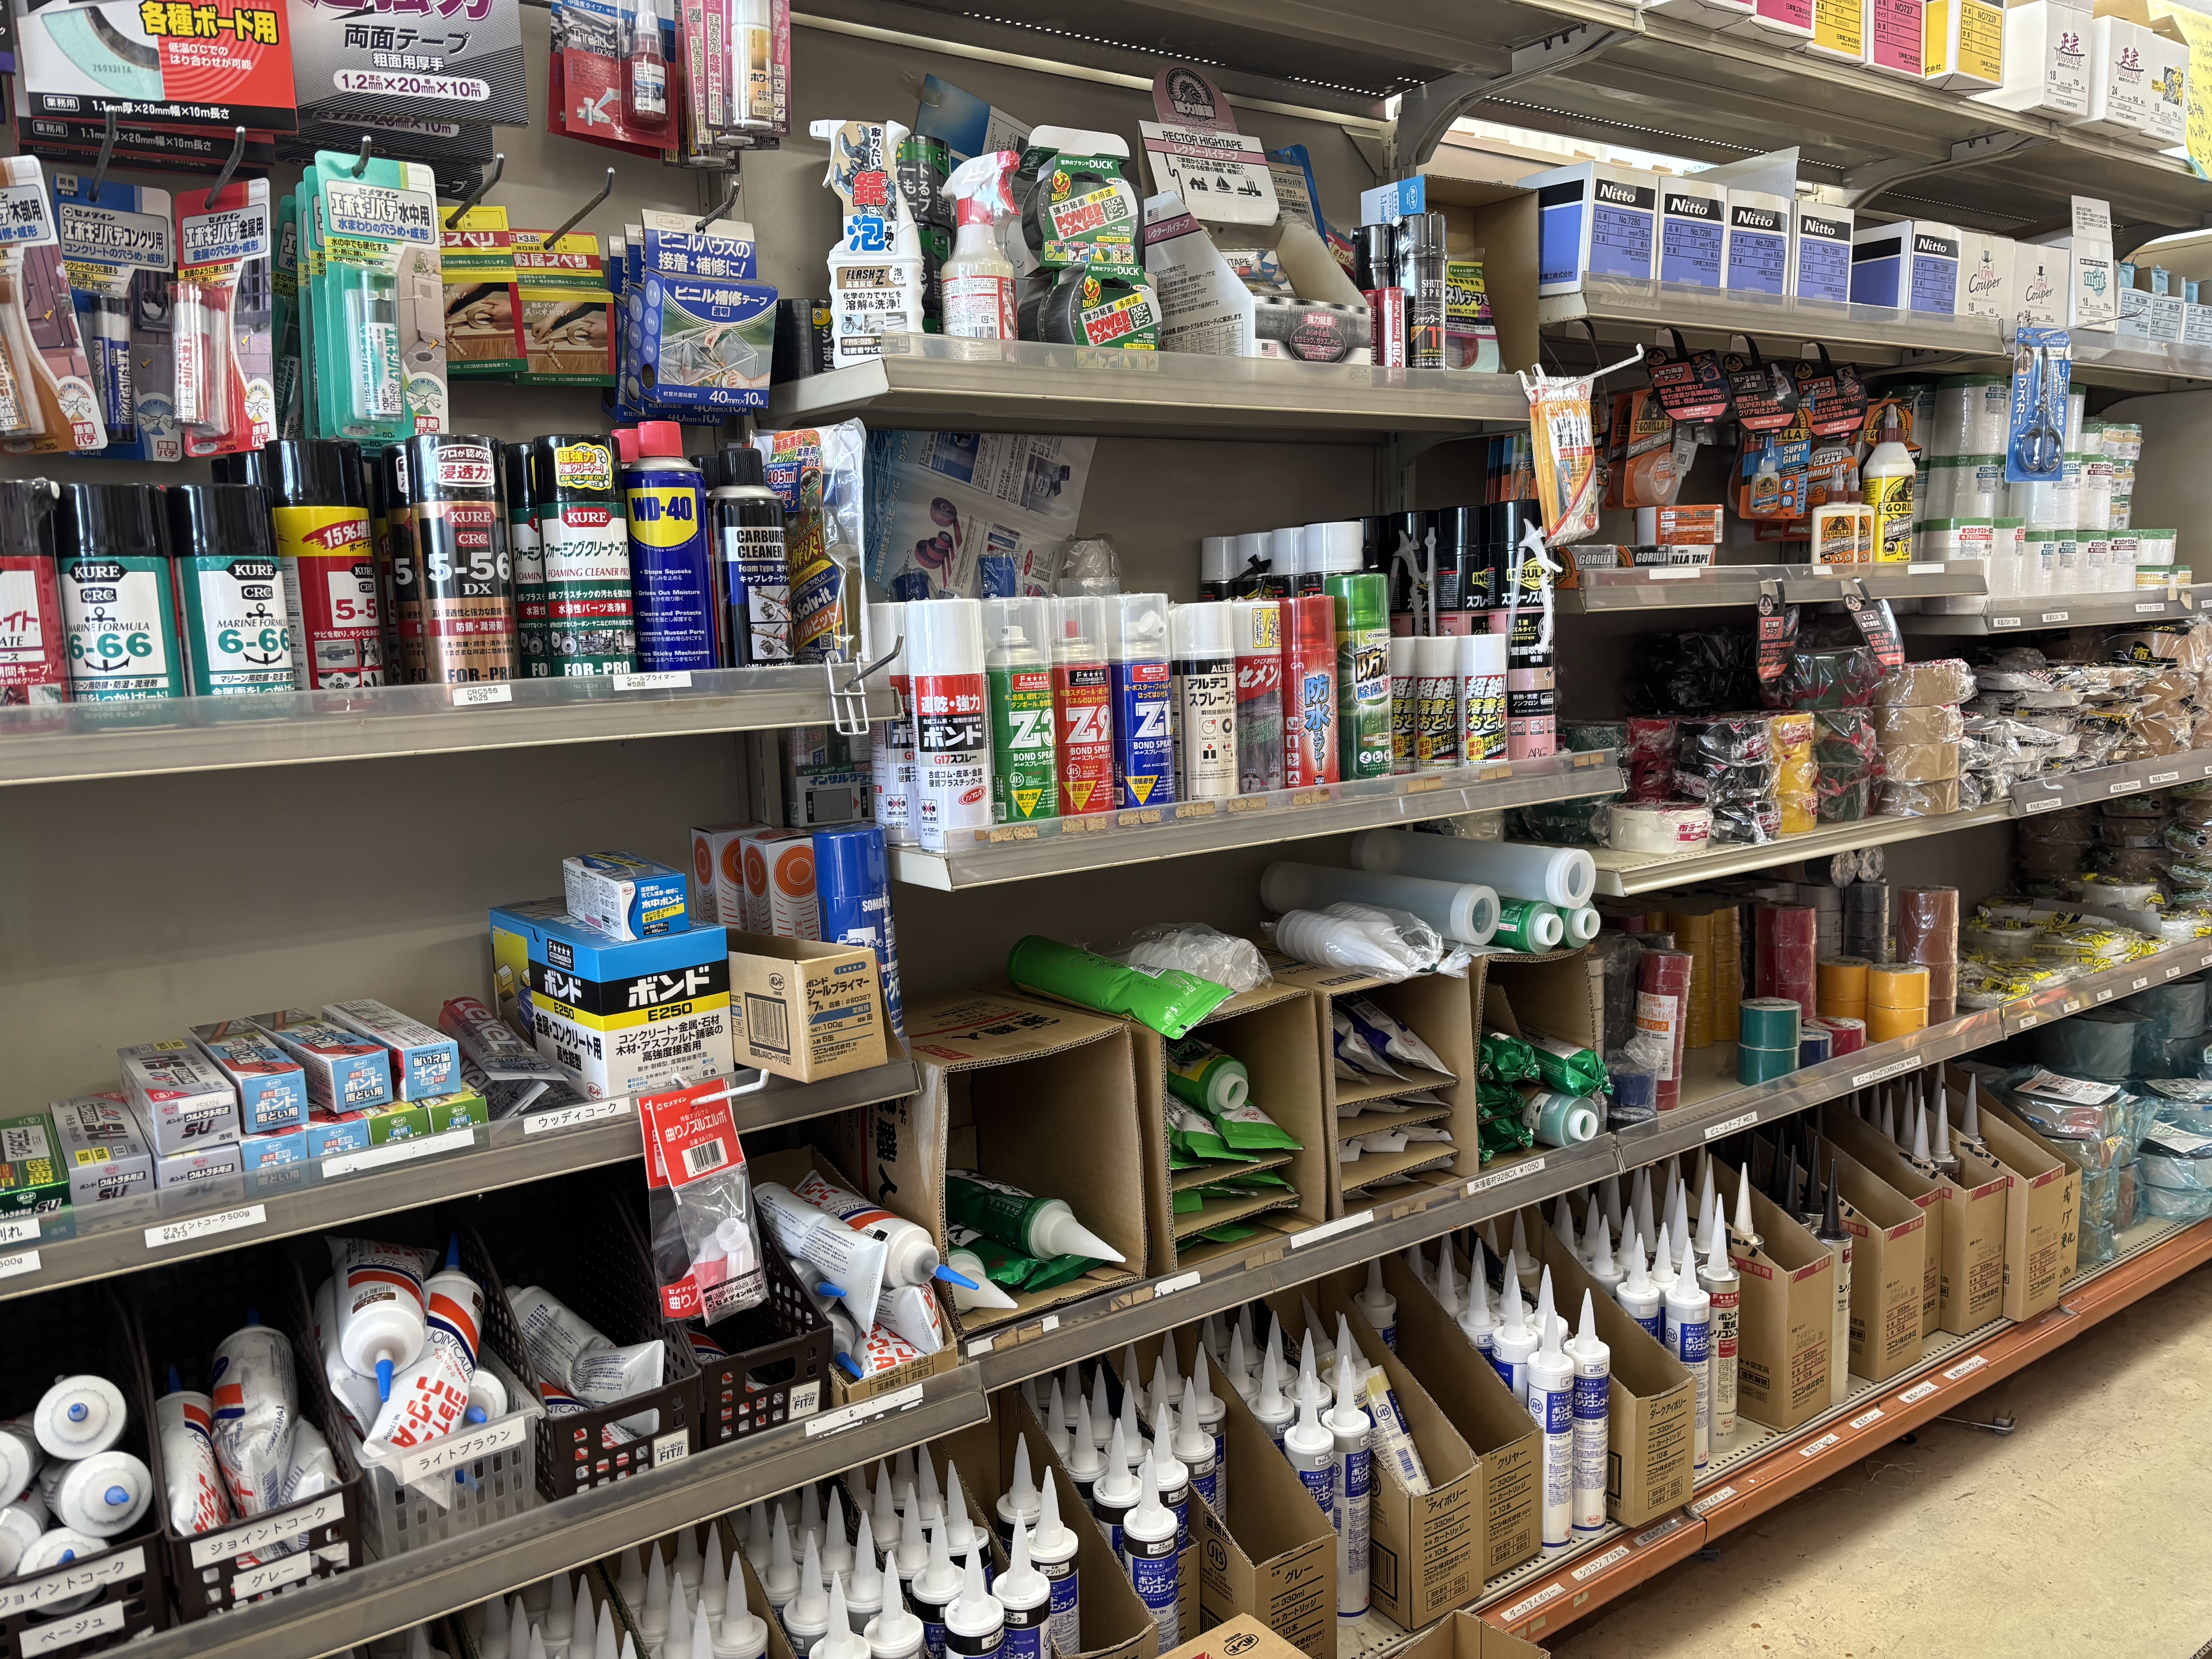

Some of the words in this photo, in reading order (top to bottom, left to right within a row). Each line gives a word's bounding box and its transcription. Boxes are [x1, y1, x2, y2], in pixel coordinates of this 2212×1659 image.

[141, 0, 279, 45] 各種ボード用
[1978, 10, 1997, 24] NO7239
[345, 24, 471, 55] 両面テープ
[572, 29, 606, 48] Thread
[709, 15, 720, 53] まぜるな
[2060, 32, 2079, 53] 正宗
[594, 47, 616, 58] Locker
[2056, 51, 2081, 66] MASAMUNE
[171, 54, 252, 70] はり合わせが可能
[373, 53, 444, 70] 粗面用厚手
[710, 54, 720, 74] 危険
[46, 98, 77, 109] 業務用
[871, 127, 882, 167] 取りたい
[1163, 130, 1197, 147] RECTOR
[1199, 136, 1243, 150] HIGHTAPE
[1175, 143, 1239, 160] レクター・ハイテープ
[1090, 160, 1113, 170] DUCK
[358, 187, 398, 199] セメダイン
[1089, 189, 1113, 201] 多用途
[1599, 184, 1636, 203] Nitto
[12, 199, 43, 224] 木部用
[1053, 199, 1085, 214] 強力粘着
[1671, 198, 1708, 215] Nitto
[74, 210, 115, 221] セメダイン
[208, 213, 240, 223] セメダイン
[1055, 207, 1102, 229] POWER
[1619, 215, 1640, 226] No.7280
[1737, 211, 1773, 227] Nitto
[338, 218, 428, 240] 水まわりの穴うめ・成形
[1060, 218, 1104, 236] TAPE
[1690, 228, 1711, 238] No.7280
[1805, 219, 1835, 236] Nitto
[193, 241, 259, 261] 金属の穴うめ・成形
[331, 238, 389, 251] 水の中でも硬化する
[657, 232, 750, 259] ビニルハウスの
[1755, 238, 1776, 248] No.7280
[1918, 238, 1947, 253] Nitto
[64, 243, 165, 264] コンクリートの穴うめ・成形
[513, 252, 588, 268] 敷居スベリ
[658, 253, 747, 278] 接着・補修に!
[846, 269, 875, 280] FLASH
[2083, 270, 2107, 292] mint
[1969, 273, 2001, 296] Couper
[675, 286, 768, 307] ビニル補修テープ
[843, 291, 902, 300] 化学の力でサビを
[2026, 284, 2054, 304] Couper
[846, 299, 901, 311] 溶解&洗浄!
[2017, 378, 2027, 426] マスカー
[1638, 420, 1666, 432] GORILLA
[438, 447, 491, 460] プロが認めた
[1784, 443, 1807, 454] SUPER
[558, 451, 596, 464] 超強力
[1783, 454, 1801, 464] GLUE
[1814, 456, 1842, 467] CLEAR
[440, 465, 493, 480] 浸透力!
[558, 464, 604, 474] 万能クリーナー!
[567, 510, 607, 524] KURE
[632, 496, 693, 522] WD-40
[450, 512, 491, 524] KURE
[459, 534, 487, 544] CRC
[738, 545, 782, 559] CLEANER
[1692, 554, 1709, 564] TAPE
[74, 565, 120, 579] KURE
[234, 564, 274, 577] KURE
[428, 552, 511, 582] 5-56
[548, 568, 582, 578] FOAMING
[585, 568, 618, 577] CLEANER
[620, 568, 629, 577] PRO
[664, 568, 692, 577] Squeaks
[82, 589, 115, 601] CRC
[462, 582, 492, 595] DX
[558, 603, 627, 614] 水溶性パーツ洗浄剤
[98, 622, 150, 632] FORMULA
[456, 621, 503, 632] 防錆・潤滑剤
[70, 632, 153, 660] 6-66
[218, 628, 289, 654] 6-66
[565, 662, 631, 676] FOR-PRO
[467, 687, 498, 695] CRC556
[1188, 677, 1228, 690] アルテコ
[921, 696, 980, 713] 速乾・強力
[1304, 674, 1330, 730] 防水
[924, 724, 982, 748] ボンド
[1008, 710, 1055, 749] Z-3
[1071, 747, 1092, 755] BOND
[1094, 745, 1110, 754] SPRAY
[1133, 741, 1153, 750] BOND
[1154, 739, 1172, 749] SPRAY
[934, 754, 977, 765] G17スプレー
[1013, 753, 1036, 762] BOND
[1037, 751, 1054, 761] SPRAY
[929, 768, 983, 779] 合成ゴム・皮革・金属
[929, 778, 983, 787] 硬質プラスチック・木
[1017, 793, 1038, 801] 強力型
[1678, 819, 1708, 832] 布テープ
[642, 895, 684, 908] 水中ボンド
[544, 970, 582, 1004] ボンド
[628, 966, 709, 1007] ボンド
[807, 978, 870, 998] シールプライマー
[554, 1002, 574, 1020] E250
[648, 1002, 692, 1022] E250
[535, 1012, 602, 1061] 金属・コンクリート用
[618, 1015, 720, 1044] コンクリート・金属・石材
[616, 1024, 723, 1055] 木材・アスファルト舗装の
[556, 1045, 582, 1071] 高性能型
[642, 1041, 702, 1062] 高強度接着用
[346, 1086, 383, 1103] 雨どい用
[663, 1097, 686, 1108] セメダイン
[185, 1107, 230, 1121] ウルトラ多用途
[256, 1106, 299, 1125] 雨どい用
[538, 1102, 617, 1128] ウッディコーク
[665, 1110, 728, 1142] 曲りノズルエルボ
[1709, 1114, 1743, 1136] ビニールテープ
[1520, 1161, 1540, 1175] ¥1050
[163, 1210, 250, 1235] ジョイントコーク500g
[163, 1230, 188, 1240] ¥473
[794, 1395, 816, 1408] FIT!!
[1649, 1398, 1687, 1420] ダークアイボリー
[420, 1429, 511, 1470] ライトブラウン
[1497, 1449, 1527, 1468] クリヤー
[1428, 1489, 1468, 1514] アイボリー
[1433, 1515, 1455, 1530] 330ml
[210, 1507, 326, 1555] ジョイントコーク
[1434, 1523, 1464, 1544] カートリッジ
[251, 1565, 295, 1586] グレー
[1285, 1565, 1313, 1584] グレー
[1509, 1587, 1556, 1617] ダークアイボリー
[41, 1616, 105, 1643] ベージュ
